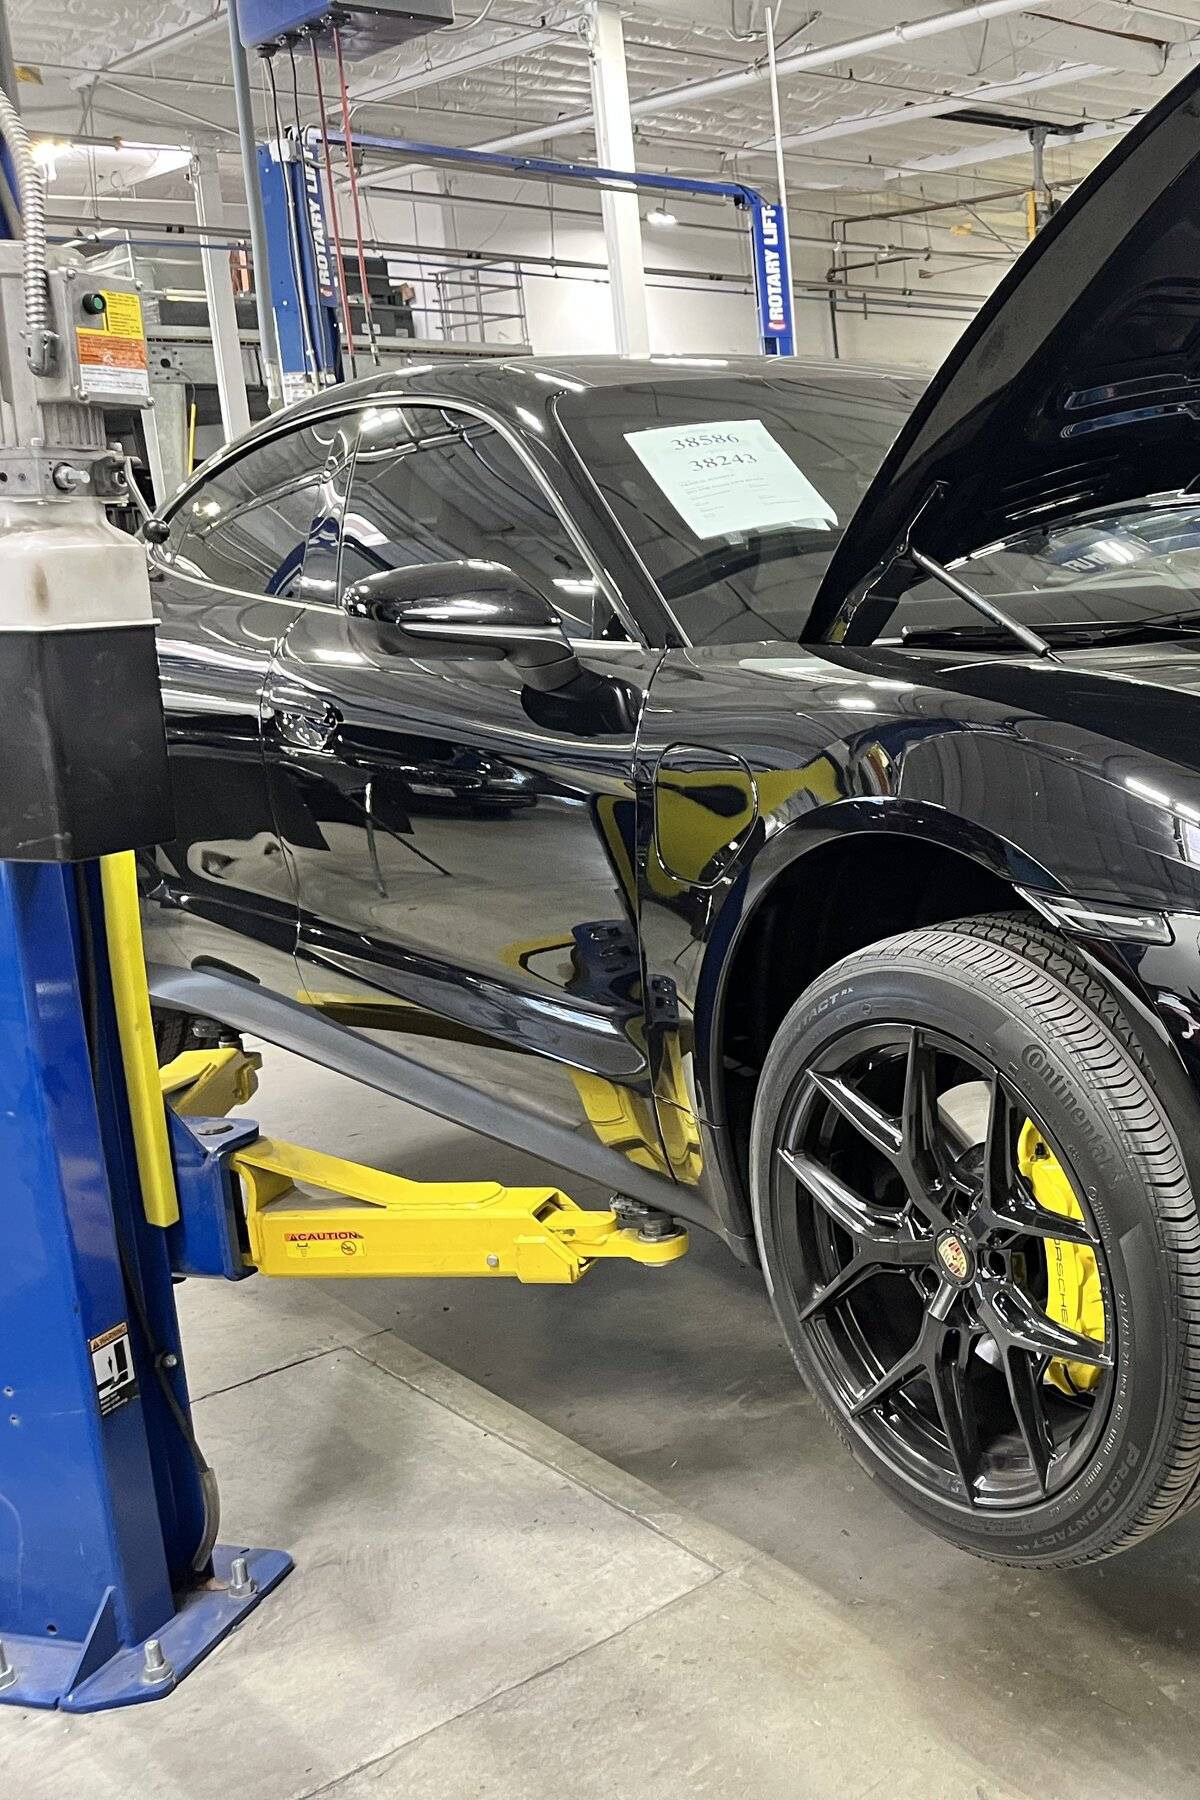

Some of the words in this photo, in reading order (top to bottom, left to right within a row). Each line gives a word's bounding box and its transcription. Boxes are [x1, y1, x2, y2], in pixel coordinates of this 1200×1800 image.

[308, 198, 331, 286] ROTARY
[761, 205, 779, 246] LIFT
[764, 248, 784, 321] ROTARY
[670, 433, 739, 450] 38586
[689, 453, 757, 471] 38243
[1021, 1043, 1114, 1165] Continental
[297, 1231, 358, 1241] CAUTION
[1054, 1239, 1069, 1324] RSCHE
